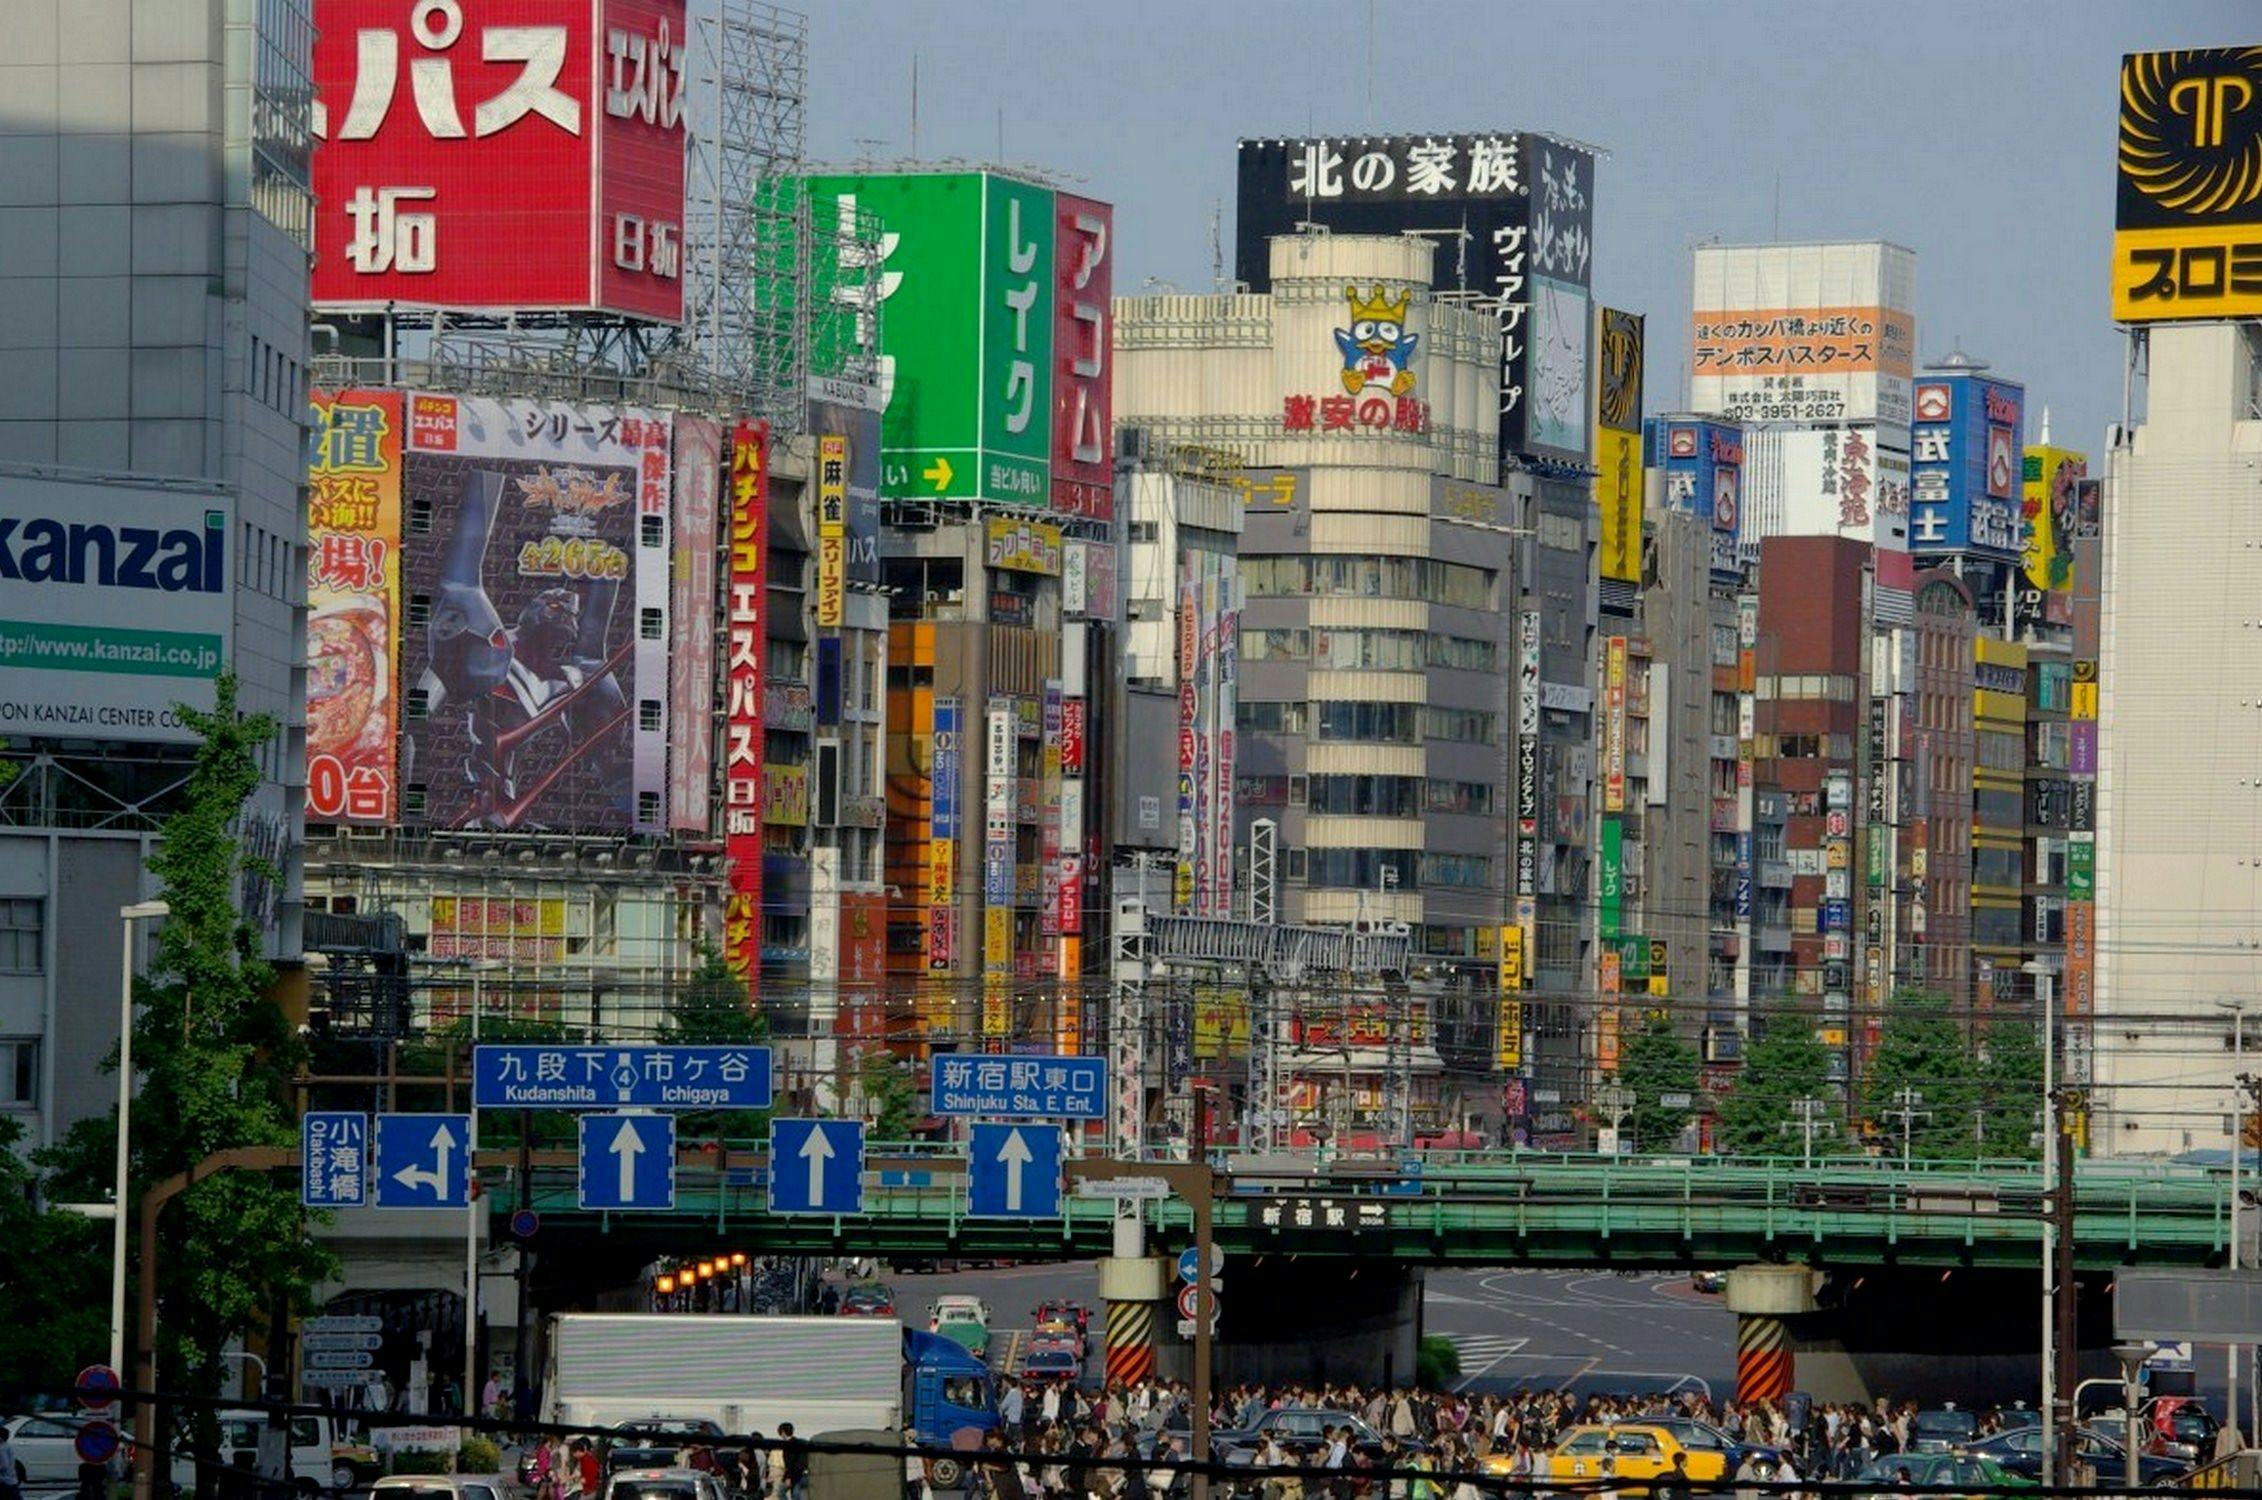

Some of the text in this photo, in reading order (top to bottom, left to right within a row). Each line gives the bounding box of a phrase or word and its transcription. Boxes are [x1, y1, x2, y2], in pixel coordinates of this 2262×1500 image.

[608, 16, 685, 130] エスパス
[1291, 141, 1519, 197] 北の家族
[615, 212, 678, 278] 日拓
[1006, 198, 1037, 433] レイク
[1073, 213, 1105, 464] アコム
[1494, 226, 1526, 413] ヴィアグループ
[414, 417, 455, 431] エスパス
[1734, 404, 1845, 419] 03-3951-2627
[823, 460, 841, 522] 麻雀
[1913, 428, 1950, 542] 武富士
[310, 535, 386, 591] 場!
[823, 538, 840, 624] スリーファイブ
[99, 706, 154, 727] CENTER
[1605, 860, 1616, 896] レイク
[498, 1052, 606, 1083] 九段下
[505, 1086, 596, 1102] Kudanshita
[662, 1086, 730, 1103] Ichigaya
[942, 1061, 1094, 1092] 新宿駅東口
[944, 1093, 1093, 1113] Shinjuku Sta. E. Ent.
[310, 1120, 327, 1199] Otakibashi
[329, 1118, 361, 1201] 小滝橋
[1262, 1208, 1345, 1227] 新宿駅
